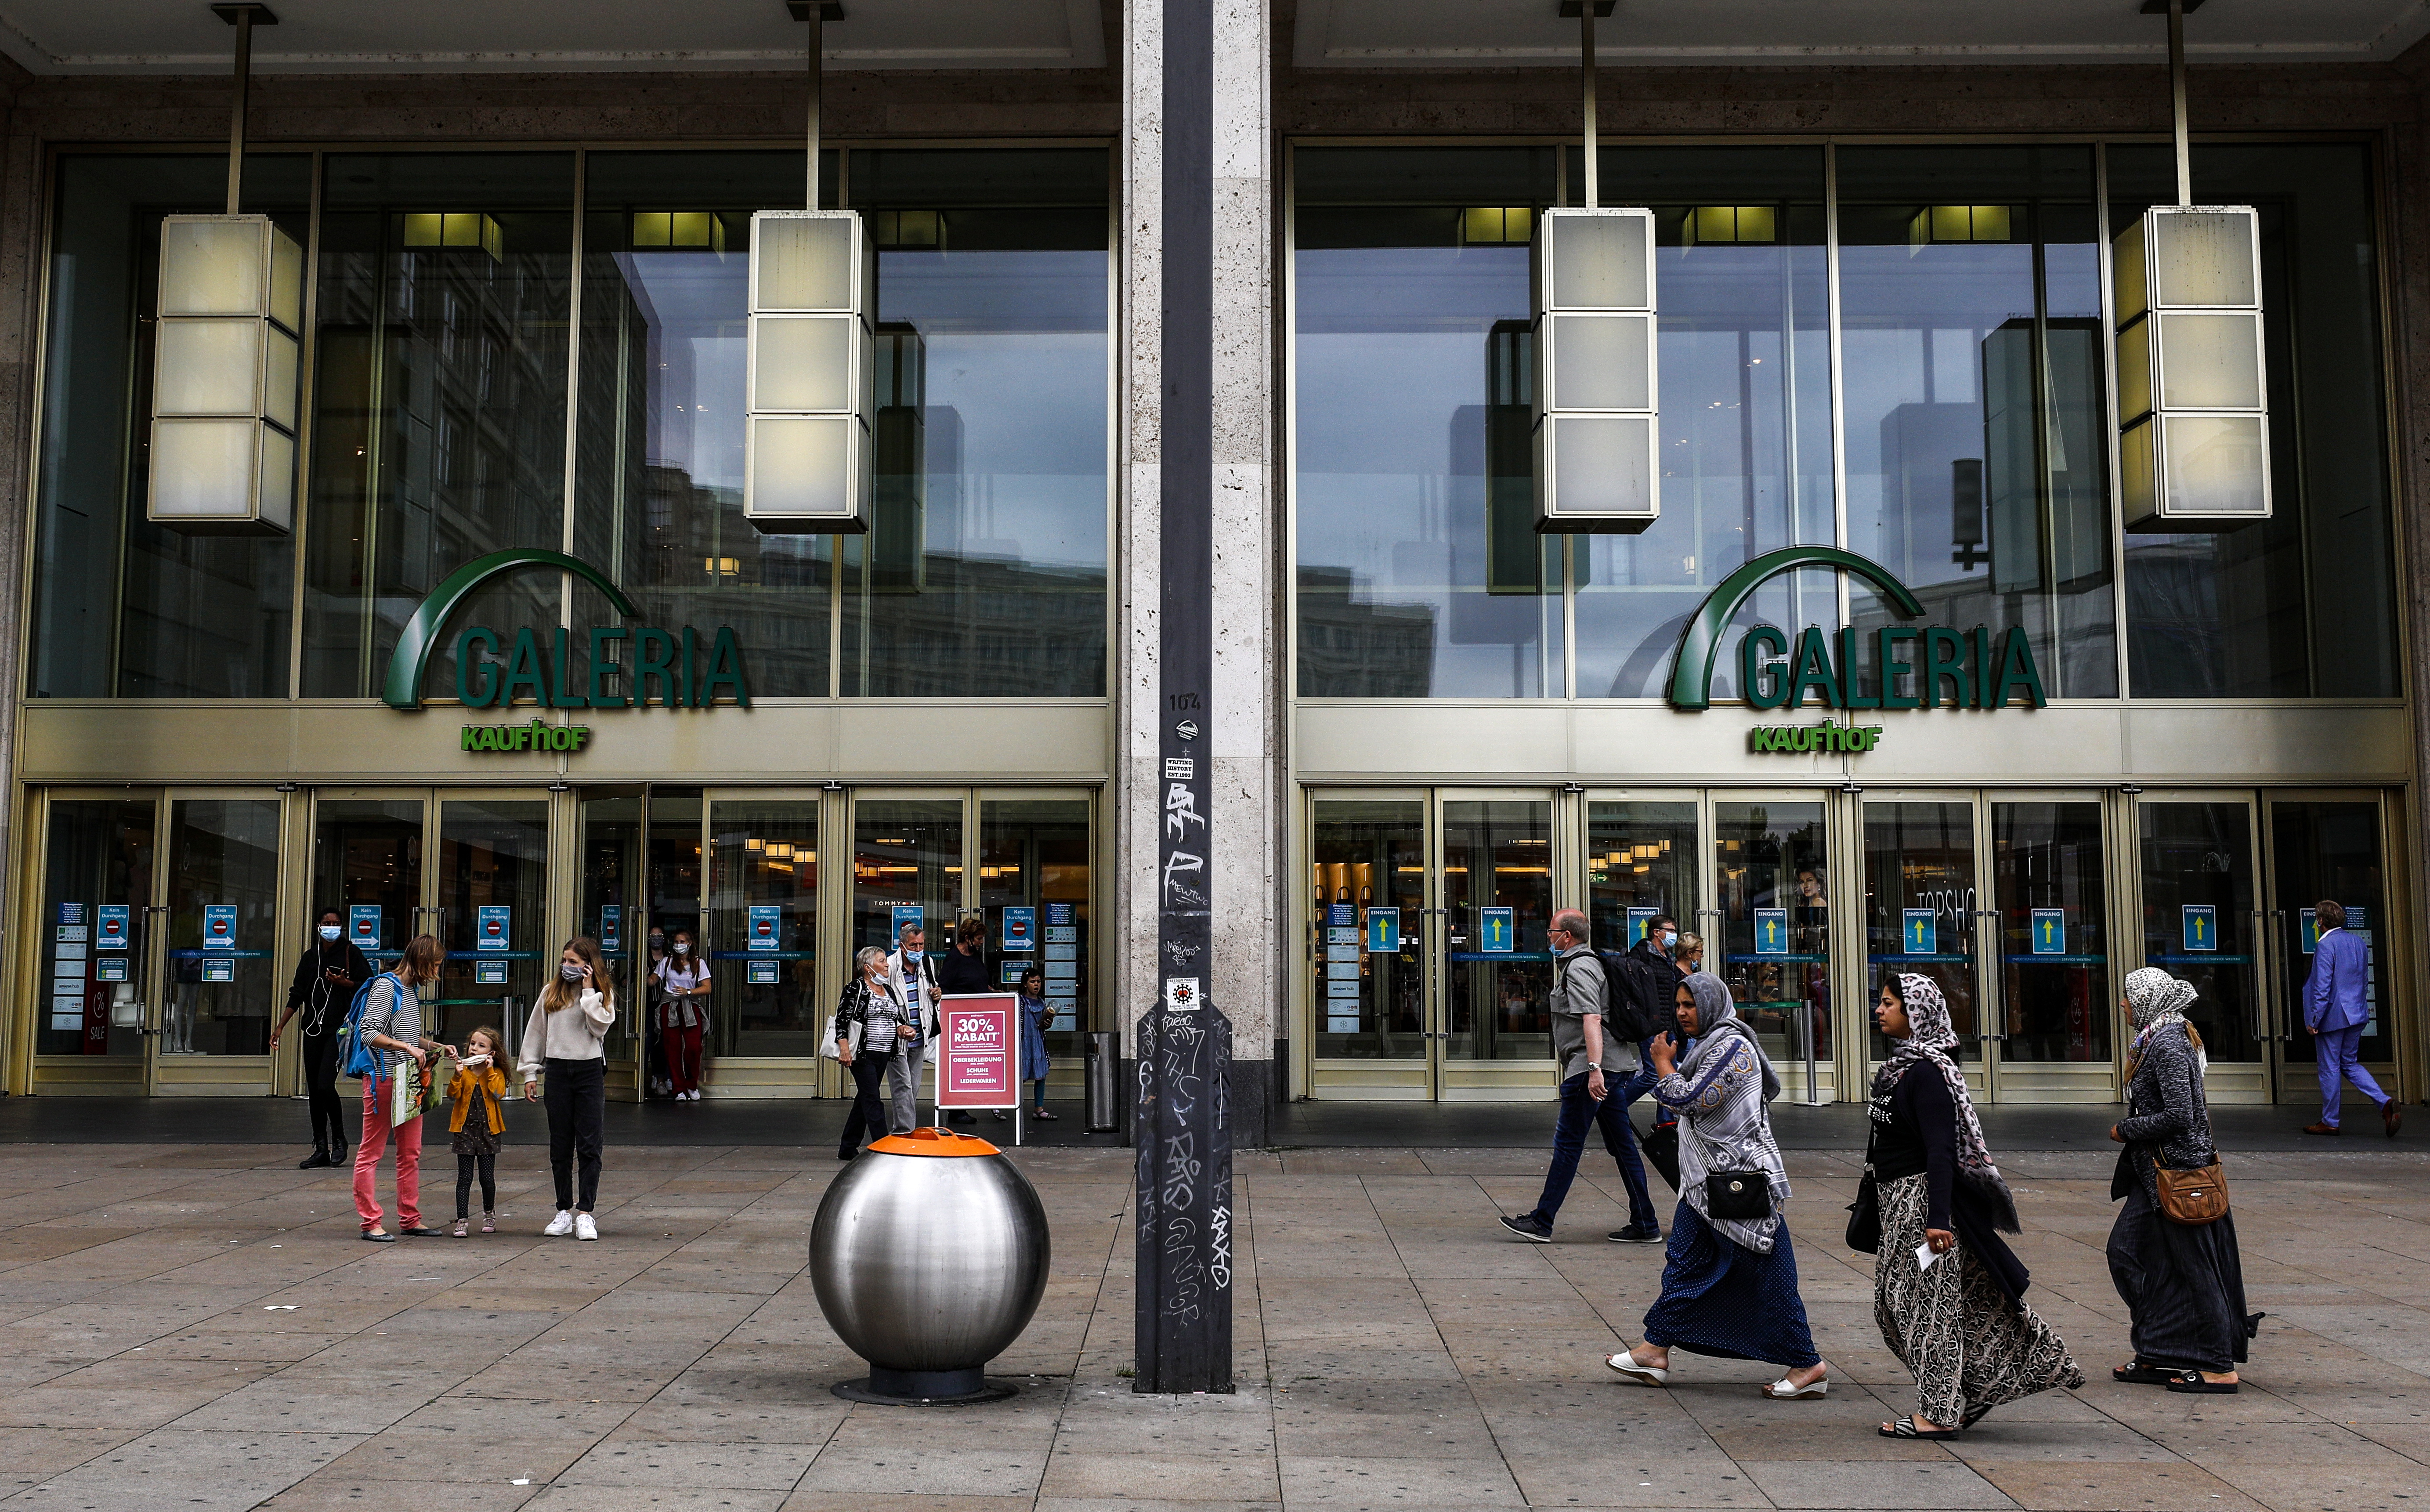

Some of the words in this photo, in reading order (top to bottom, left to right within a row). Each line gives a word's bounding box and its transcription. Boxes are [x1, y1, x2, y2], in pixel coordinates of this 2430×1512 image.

[456, 626, 752, 708] GALERIA
[1743, 625, 2047, 708] GALERIA
[1169, 692, 1201, 711] 104
[1916, 887, 1974, 931] TOPSHO
[90, 1026, 105, 1040] SALE
[958, 1018, 994, 1032] 30%
